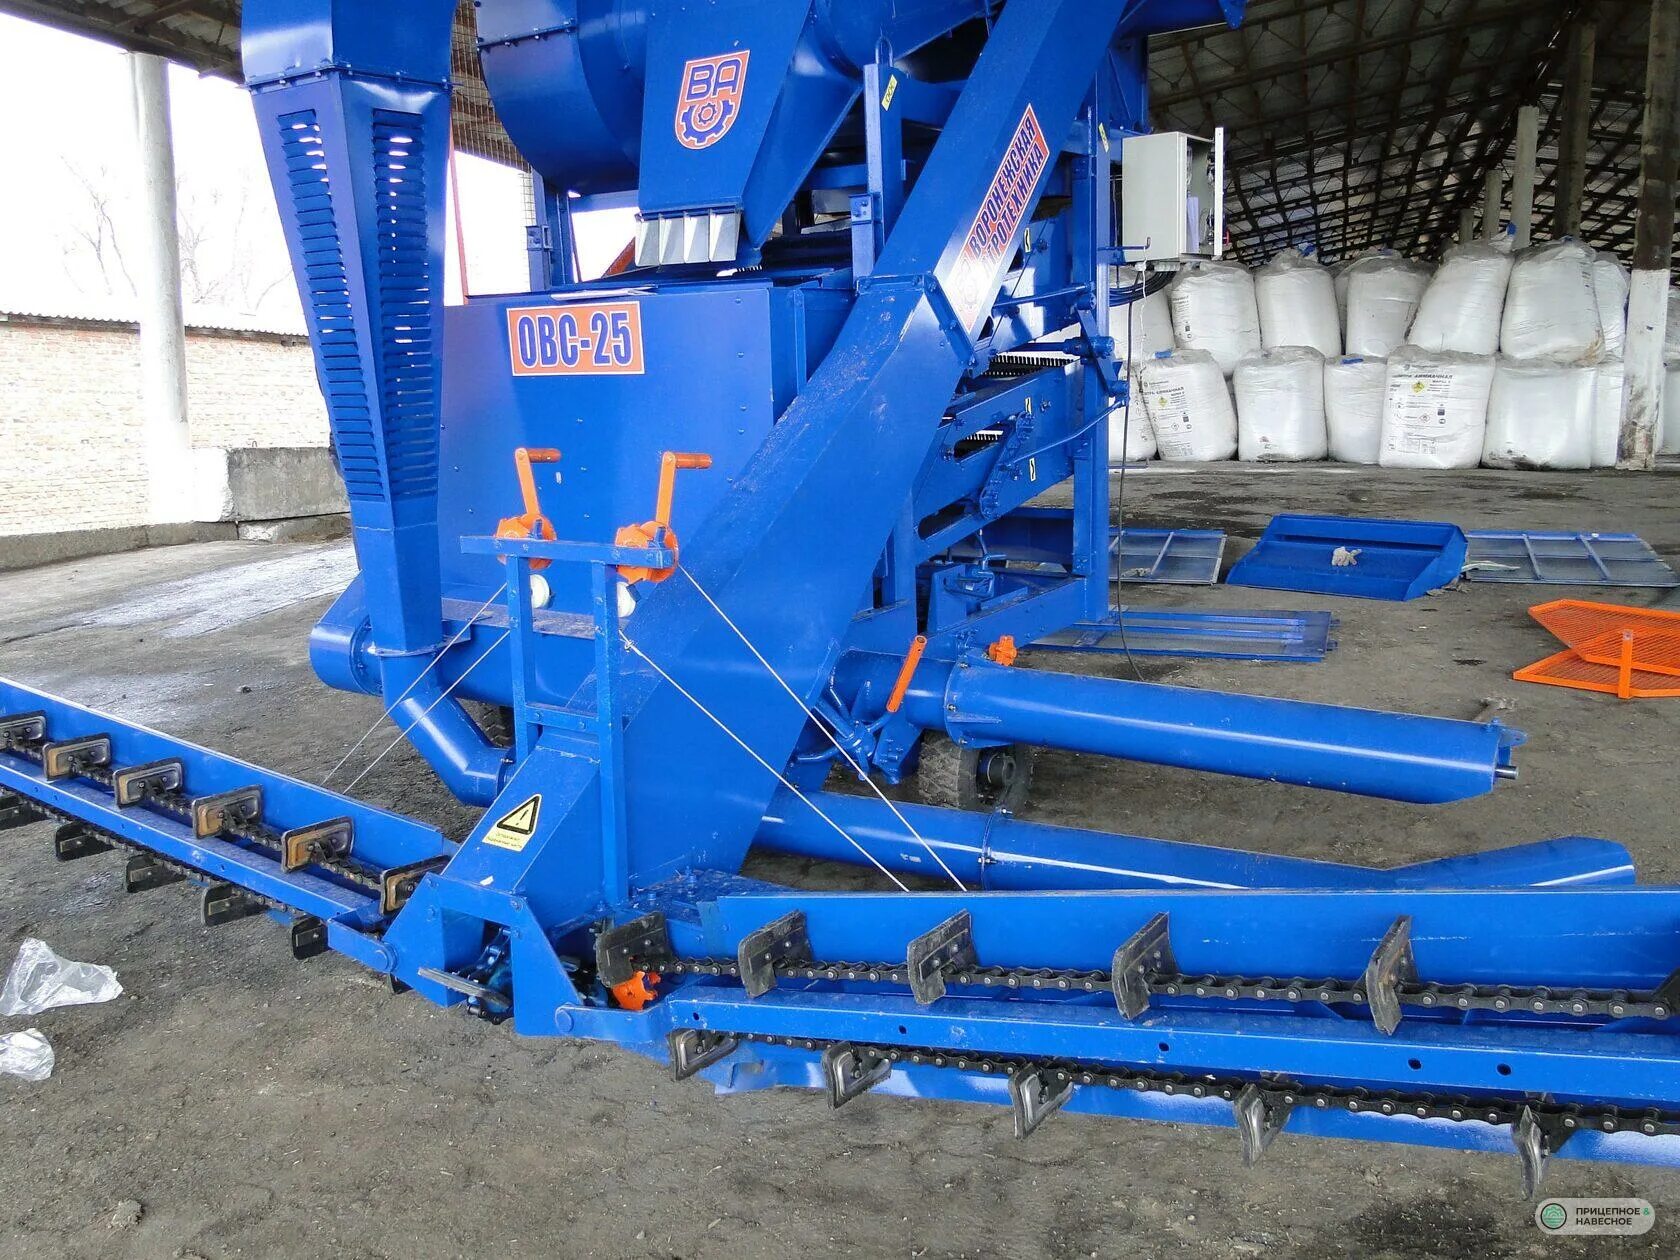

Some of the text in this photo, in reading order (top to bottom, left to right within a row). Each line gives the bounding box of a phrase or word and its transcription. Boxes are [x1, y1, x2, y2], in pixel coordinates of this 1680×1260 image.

[686, 58, 742, 101] ВА
[969, 116, 1036, 257] ВОРОНЕЖСКАЯ
[517, 310, 634, 368] ОВС-25
